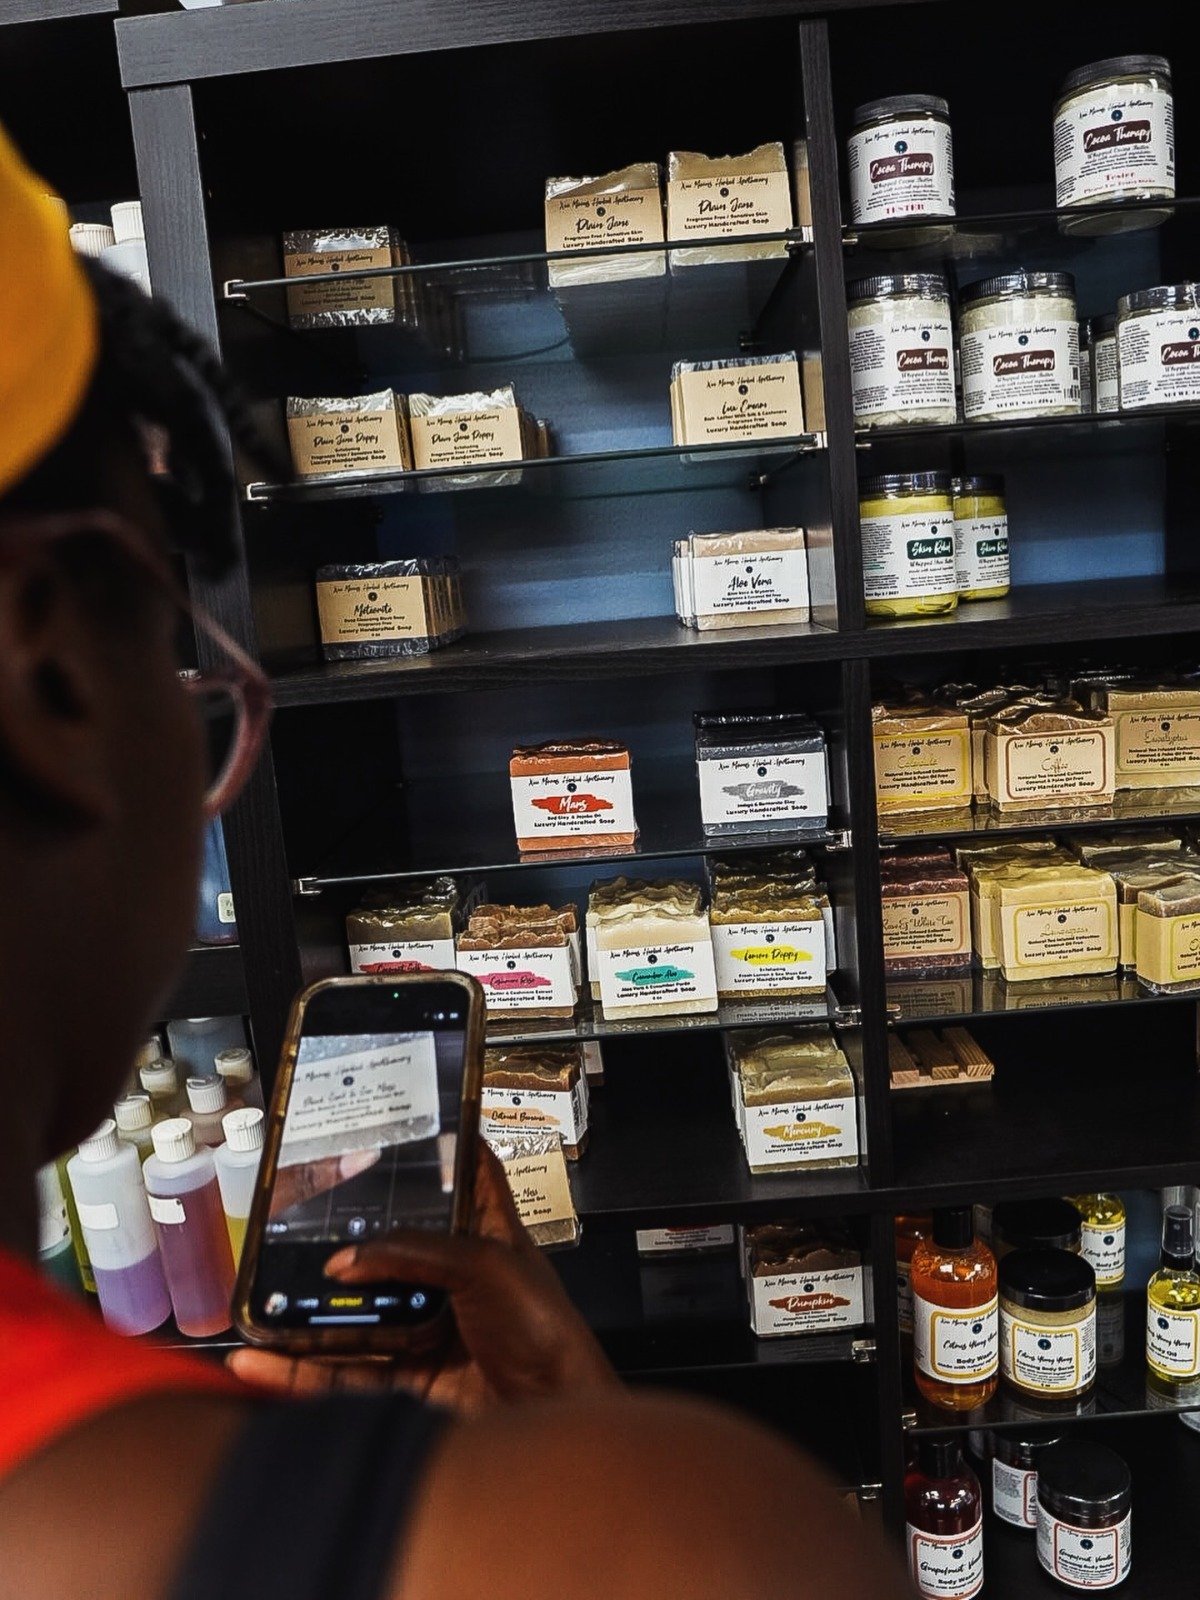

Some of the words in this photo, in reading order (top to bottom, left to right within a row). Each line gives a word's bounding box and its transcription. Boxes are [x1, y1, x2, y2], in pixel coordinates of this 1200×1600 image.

[1085, 133, 1111, 151] Cocoa
[1113, 126, 1151, 145] Therapy
[871, 161, 897, 180] Cocoa
[898, 155, 934, 176] Therapy
[698, 199, 726, 214] Plain
[730, 197, 753, 213] Jane
[576, 218, 603, 234] Plain
[606, 215, 629, 231] Jane
[684, 222, 707, 230] Luxury
[709, 219, 750, 227] Handcrafted
[563, 241, 584, 249] Luxury
[586, 238, 625, 246] Handcrafted
[898, 352, 923, 368] Cocoa
[1162, 346, 1189, 362] Cocoa
[993, 356, 1019, 373] Cocoa
[1020, 353, 1055, 370] Therapy
[706, 426, 728, 434] Luxury
[730, 423, 768, 431] Handcrafted
[911, 541, 932, 556] Skin
[728, 575, 748, 591] Aloe
[751, 573, 772, 589] Vera
[353, 602, 393, 617] Meteorite
[735, 598, 772, 606] Handcrafted
[746, 782, 782, 799] Gravity
[901, 780, 938, 788] Handcrafted
[1037, 781, 1076, 789] Handcrafted
[559, 794, 590, 813] Mars
[726, 808, 748, 816] Luxury
[749, 805, 789, 813] Handcrafted
[557, 817, 597, 825] Handcrafted
[599, 816, 616, 824] Soap
[744, 950, 769, 962] Lemon
[639, 987, 678, 996] Handcrafted
[533, 1208, 552, 1217] Soap
[787, 1296, 835, 1311] Pumpkin
